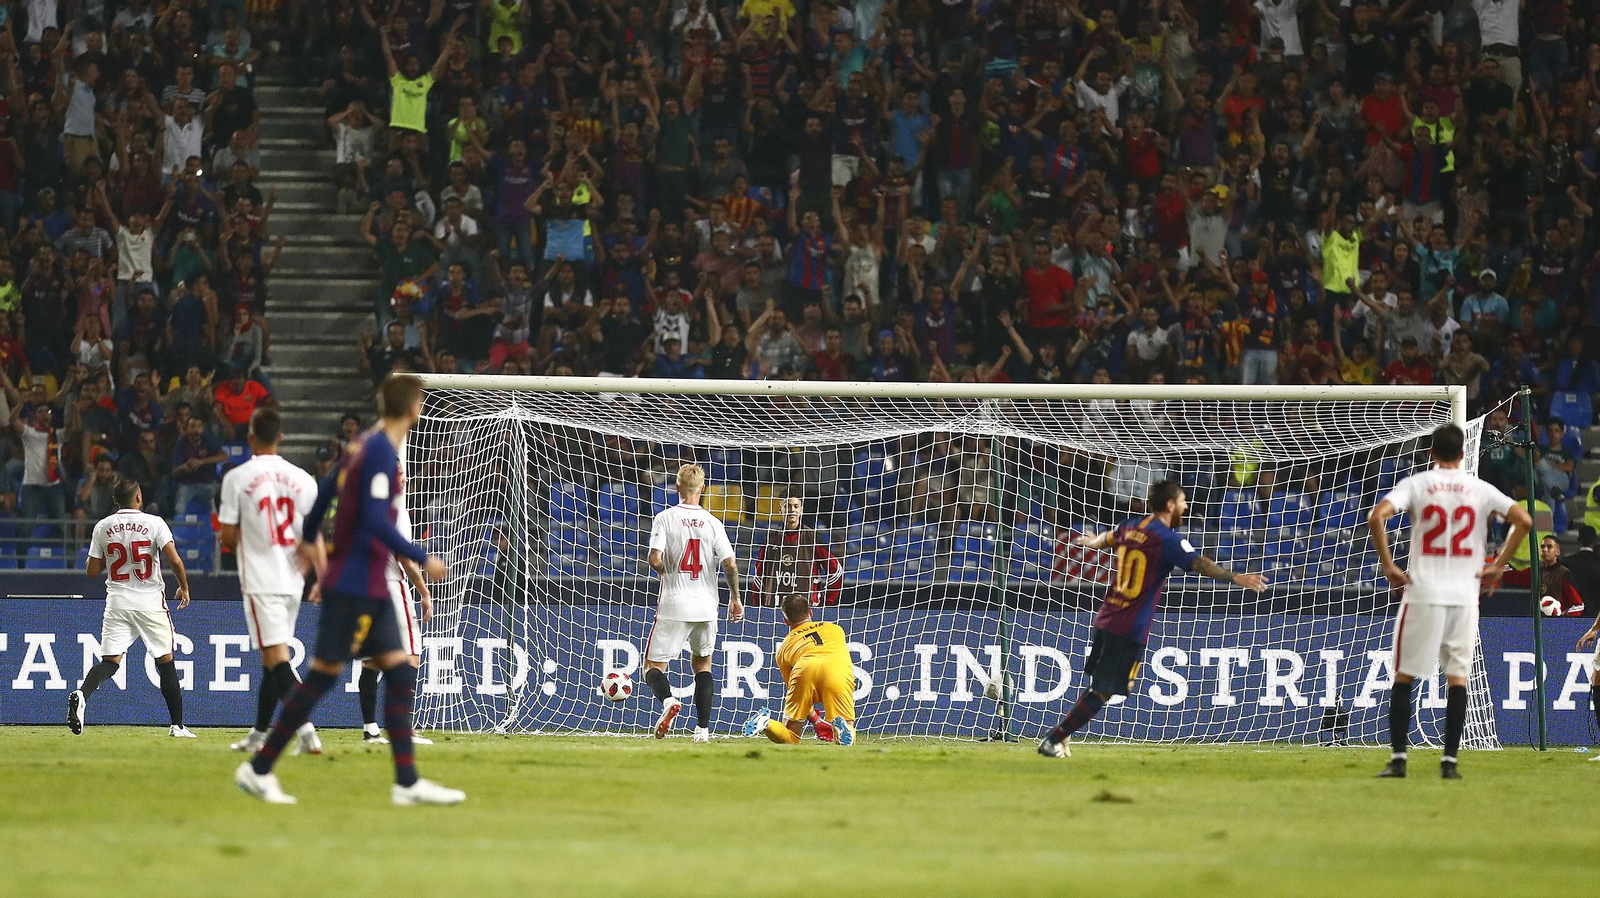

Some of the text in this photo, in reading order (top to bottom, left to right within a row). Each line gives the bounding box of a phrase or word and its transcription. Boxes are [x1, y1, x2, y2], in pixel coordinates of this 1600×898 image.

[106, 522, 149, 538] MERCADO
[256, 496, 296, 547] 12
[1420, 503, 1476, 557] 22
[106, 540, 153, 582] 25
[679, 538, 703, 580] 4
[1116, 544, 1148, 599] 10
[345, 637, 558, 696] ED:
